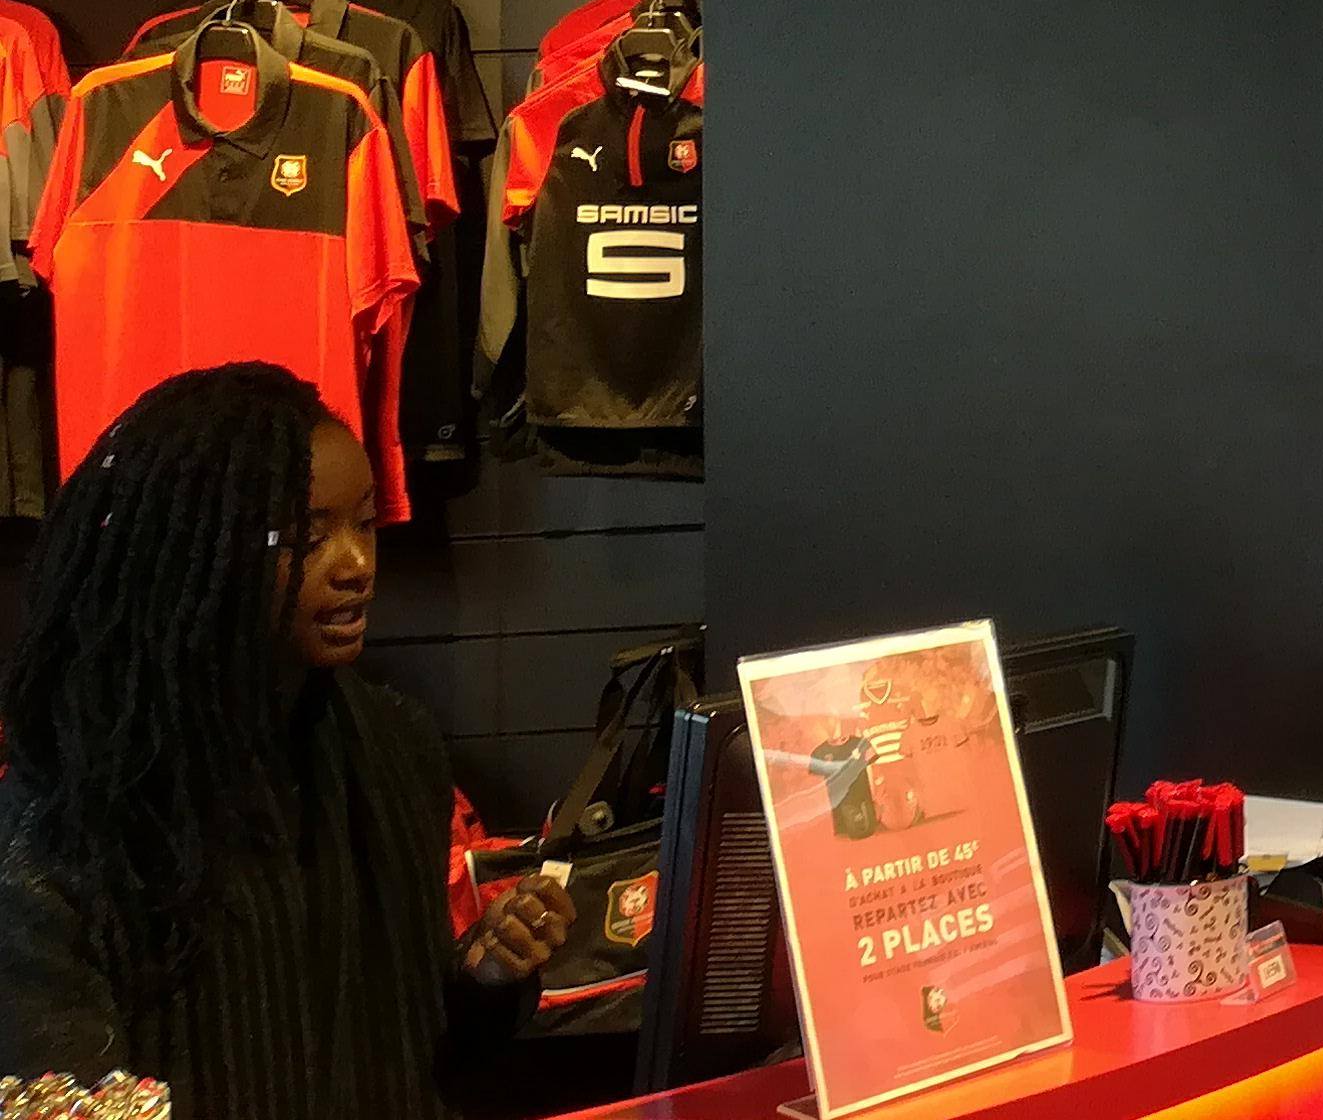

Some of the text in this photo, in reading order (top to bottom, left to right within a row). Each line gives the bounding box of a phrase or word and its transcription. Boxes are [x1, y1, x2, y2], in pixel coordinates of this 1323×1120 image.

[576, 204, 698, 224] SAMSIC
[586, 230, 686, 299] S
[861, 855, 924, 886] PARTIR
[927, 848, 950, 868] DE
[852, 881, 988, 930] REPARTEZ AVEC
[858, 936, 877, 967] 2
[882, 903, 995, 960] PLACES
